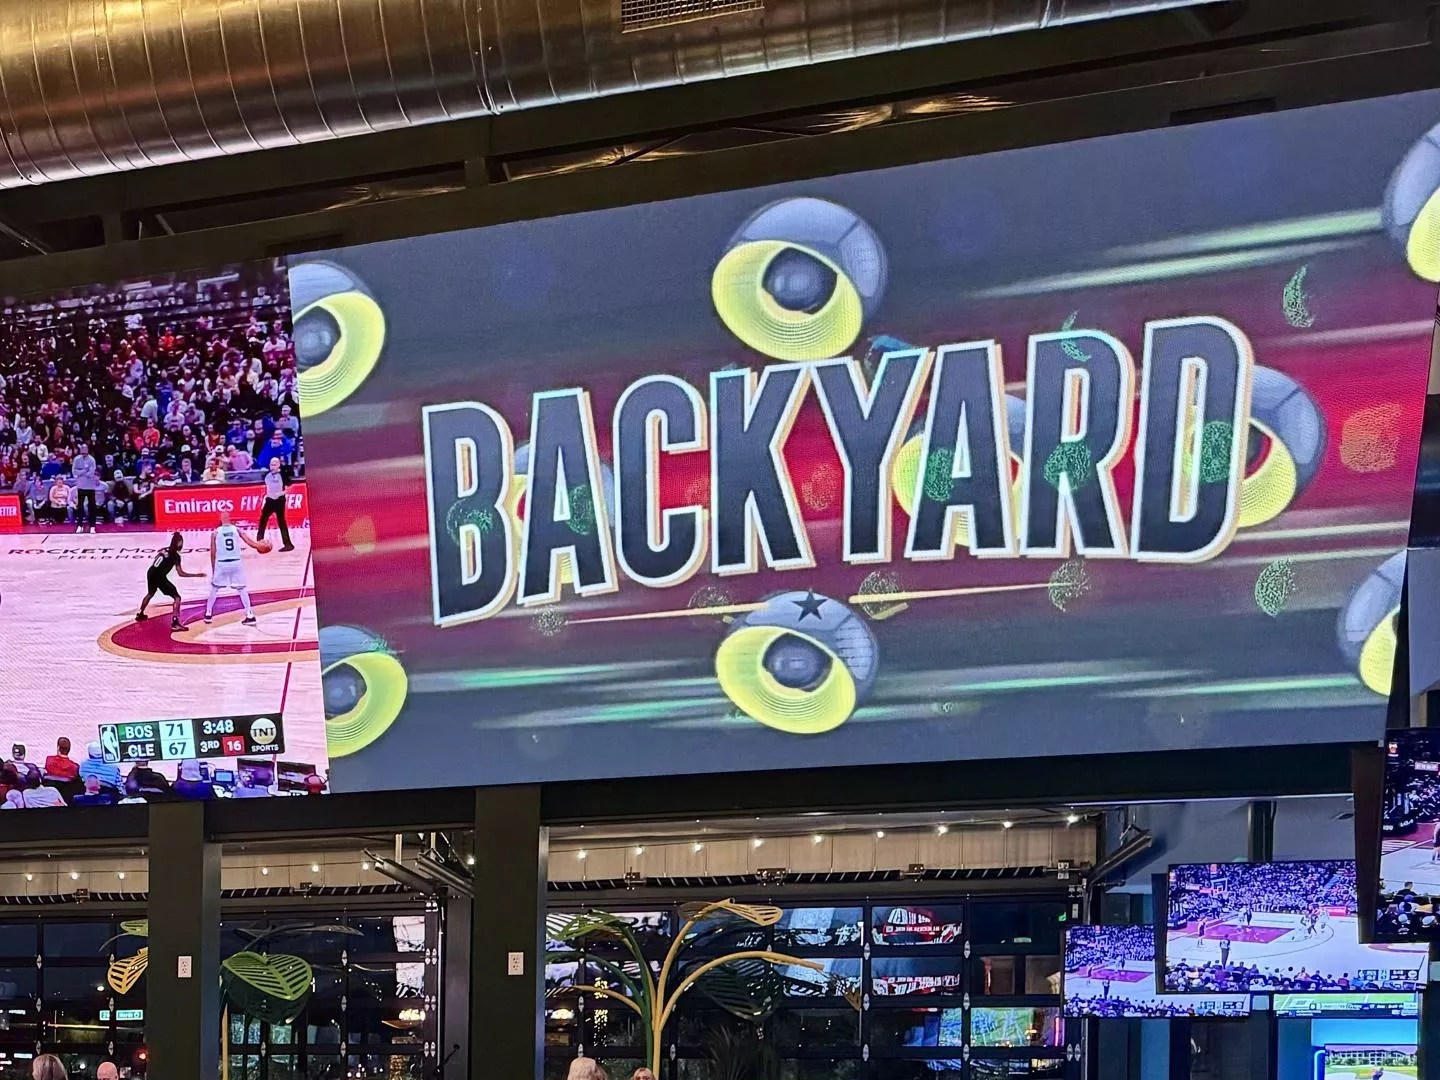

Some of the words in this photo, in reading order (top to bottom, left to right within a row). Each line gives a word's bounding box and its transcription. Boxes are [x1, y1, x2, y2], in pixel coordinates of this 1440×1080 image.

[421, 314, 1256, 627] BACKYARD
[164, 499, 234, 513] Emirates
[240, 495, 260, 511] FLY
[225, 538, 235, 551] 9
[125, 725, 154, 739] BOS
[166, 723, 185, 737] 71
[203, 719, 234, 734] 3:48
[251, 727, 276, 738] TNT
[127, 743, 156, 757] CLE
[169, 742, 187, 756] 67
[200, 740, 220, 753] 3RD
[227, 741, 242, 752] 16
[251, 743, 279, 753] SPORTS
